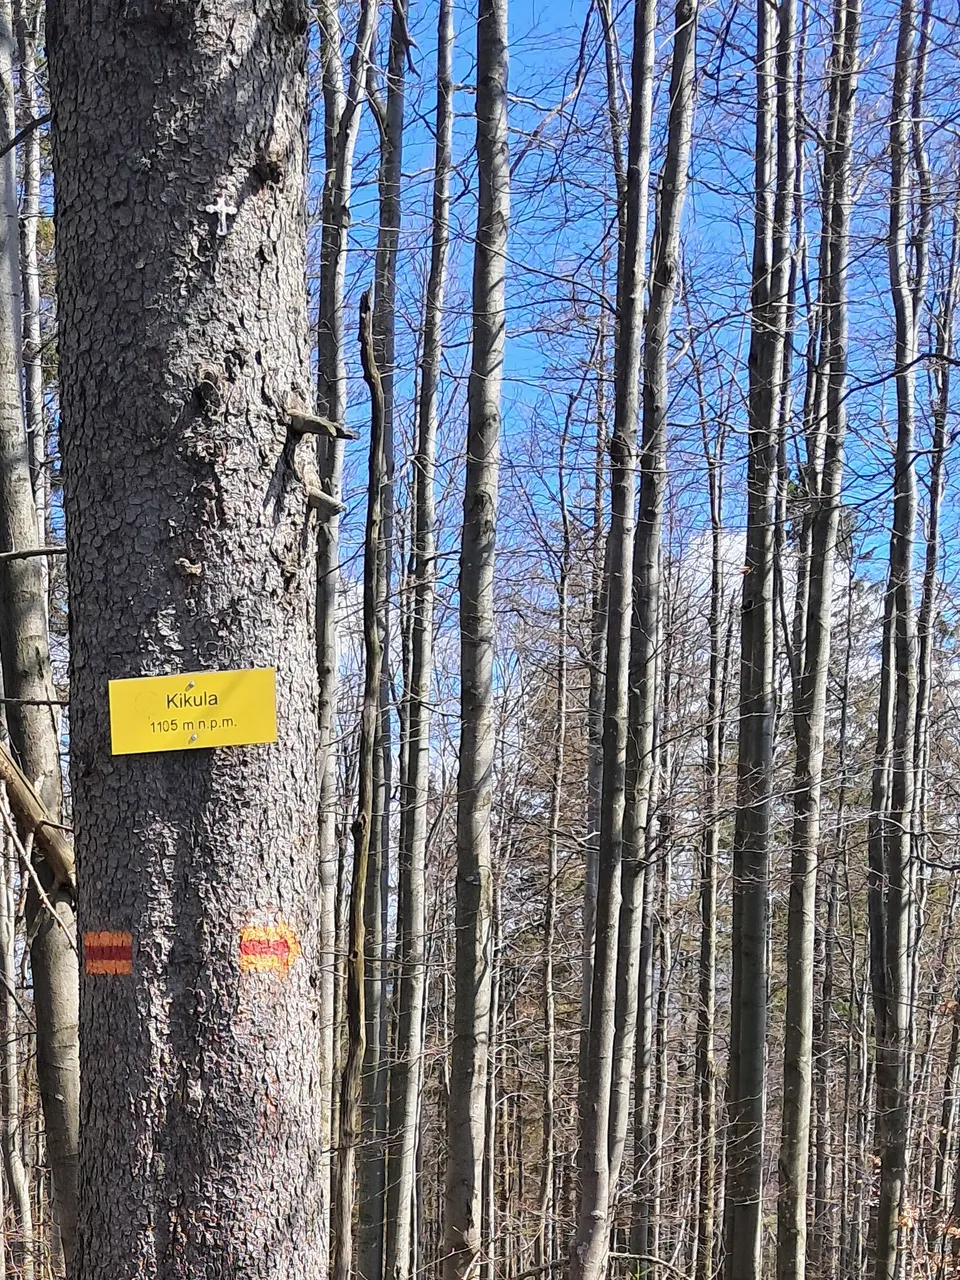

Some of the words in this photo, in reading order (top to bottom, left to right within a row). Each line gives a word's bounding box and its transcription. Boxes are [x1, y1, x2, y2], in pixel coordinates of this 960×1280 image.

[166, 691, 218, 709] Kikula
[150, 719, 178, 733] 1105
[182, 721, 194, 731] m
[198, 718, 237, 732] n.p.m.
